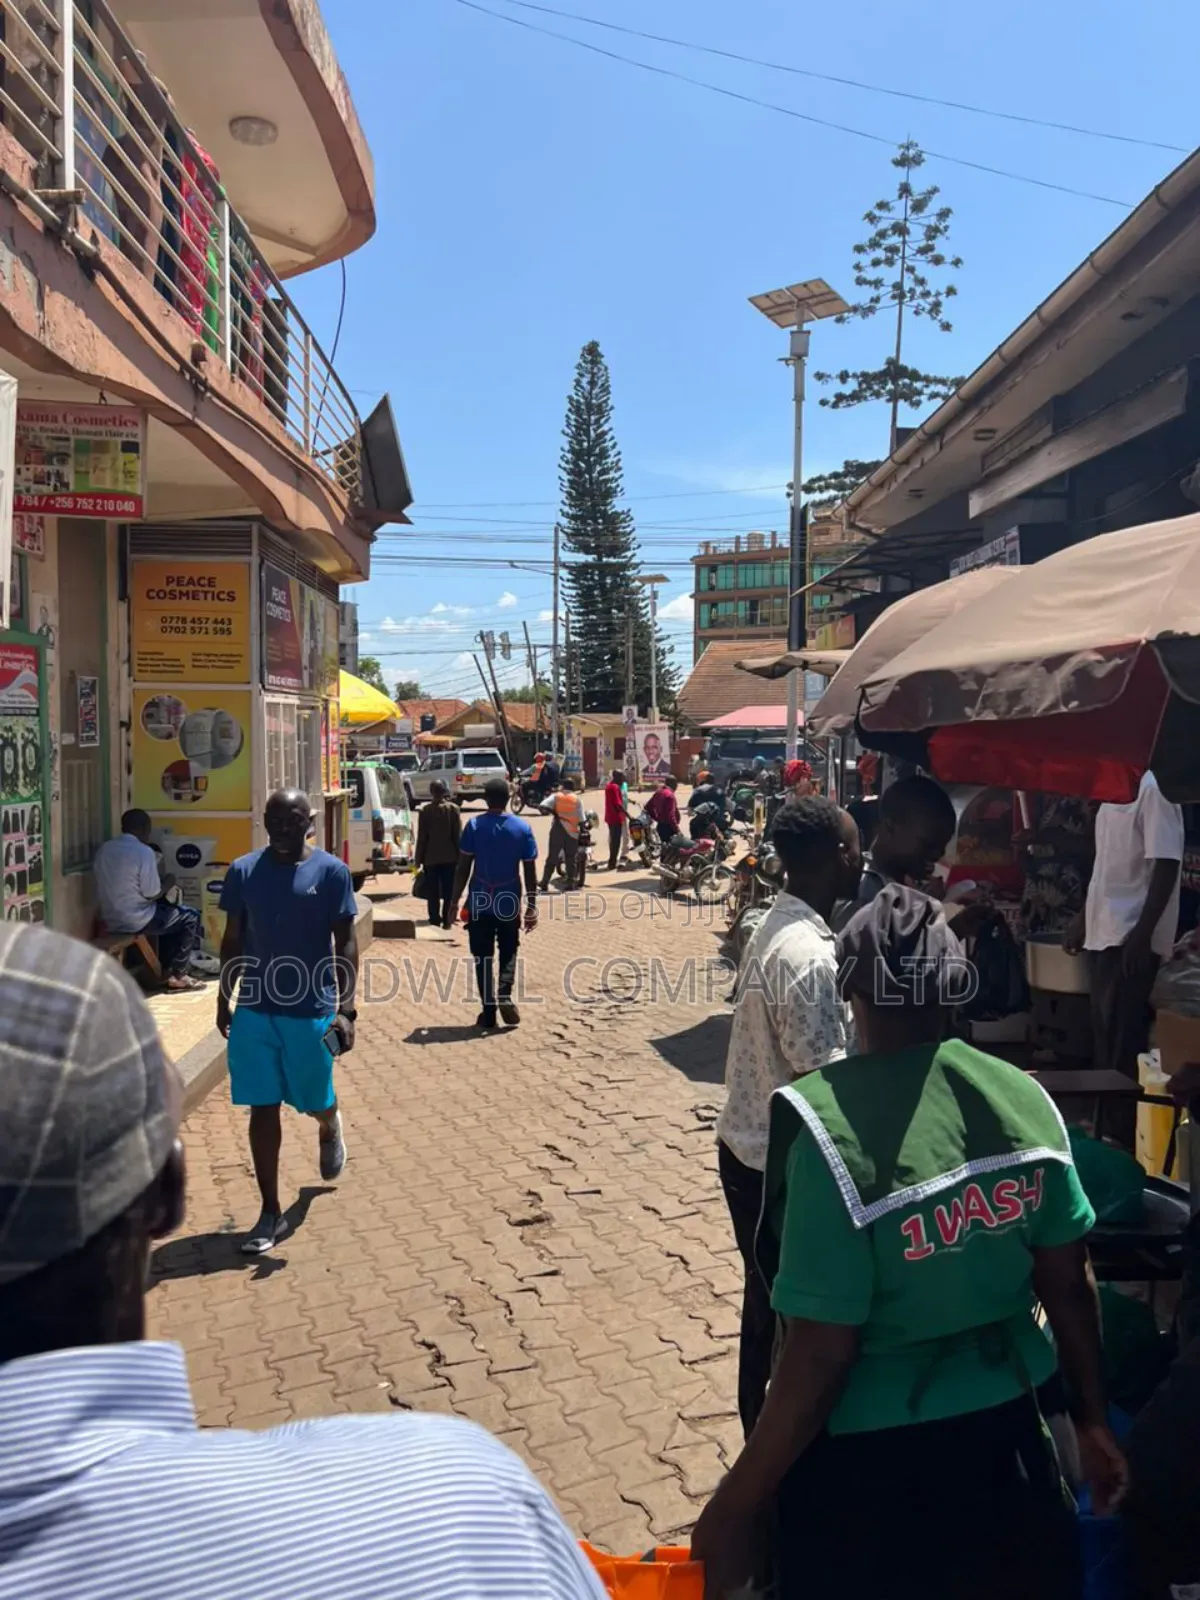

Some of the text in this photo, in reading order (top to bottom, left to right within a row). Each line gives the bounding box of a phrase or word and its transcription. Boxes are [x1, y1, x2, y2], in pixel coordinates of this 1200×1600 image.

[62, 411, 139, 428] Cosmetics
[96, 499, 115, 511] 210
[116, 500, 136, 512] 040
[165, 575, 217, 588] PEACE
[145, 588, 237, 602] COSMETICS
[272, 586, 287, 604] PEACE
[160, 615, 232, 626] 0778 457 443
[160, 625, 232, 636] 0702 571 595
